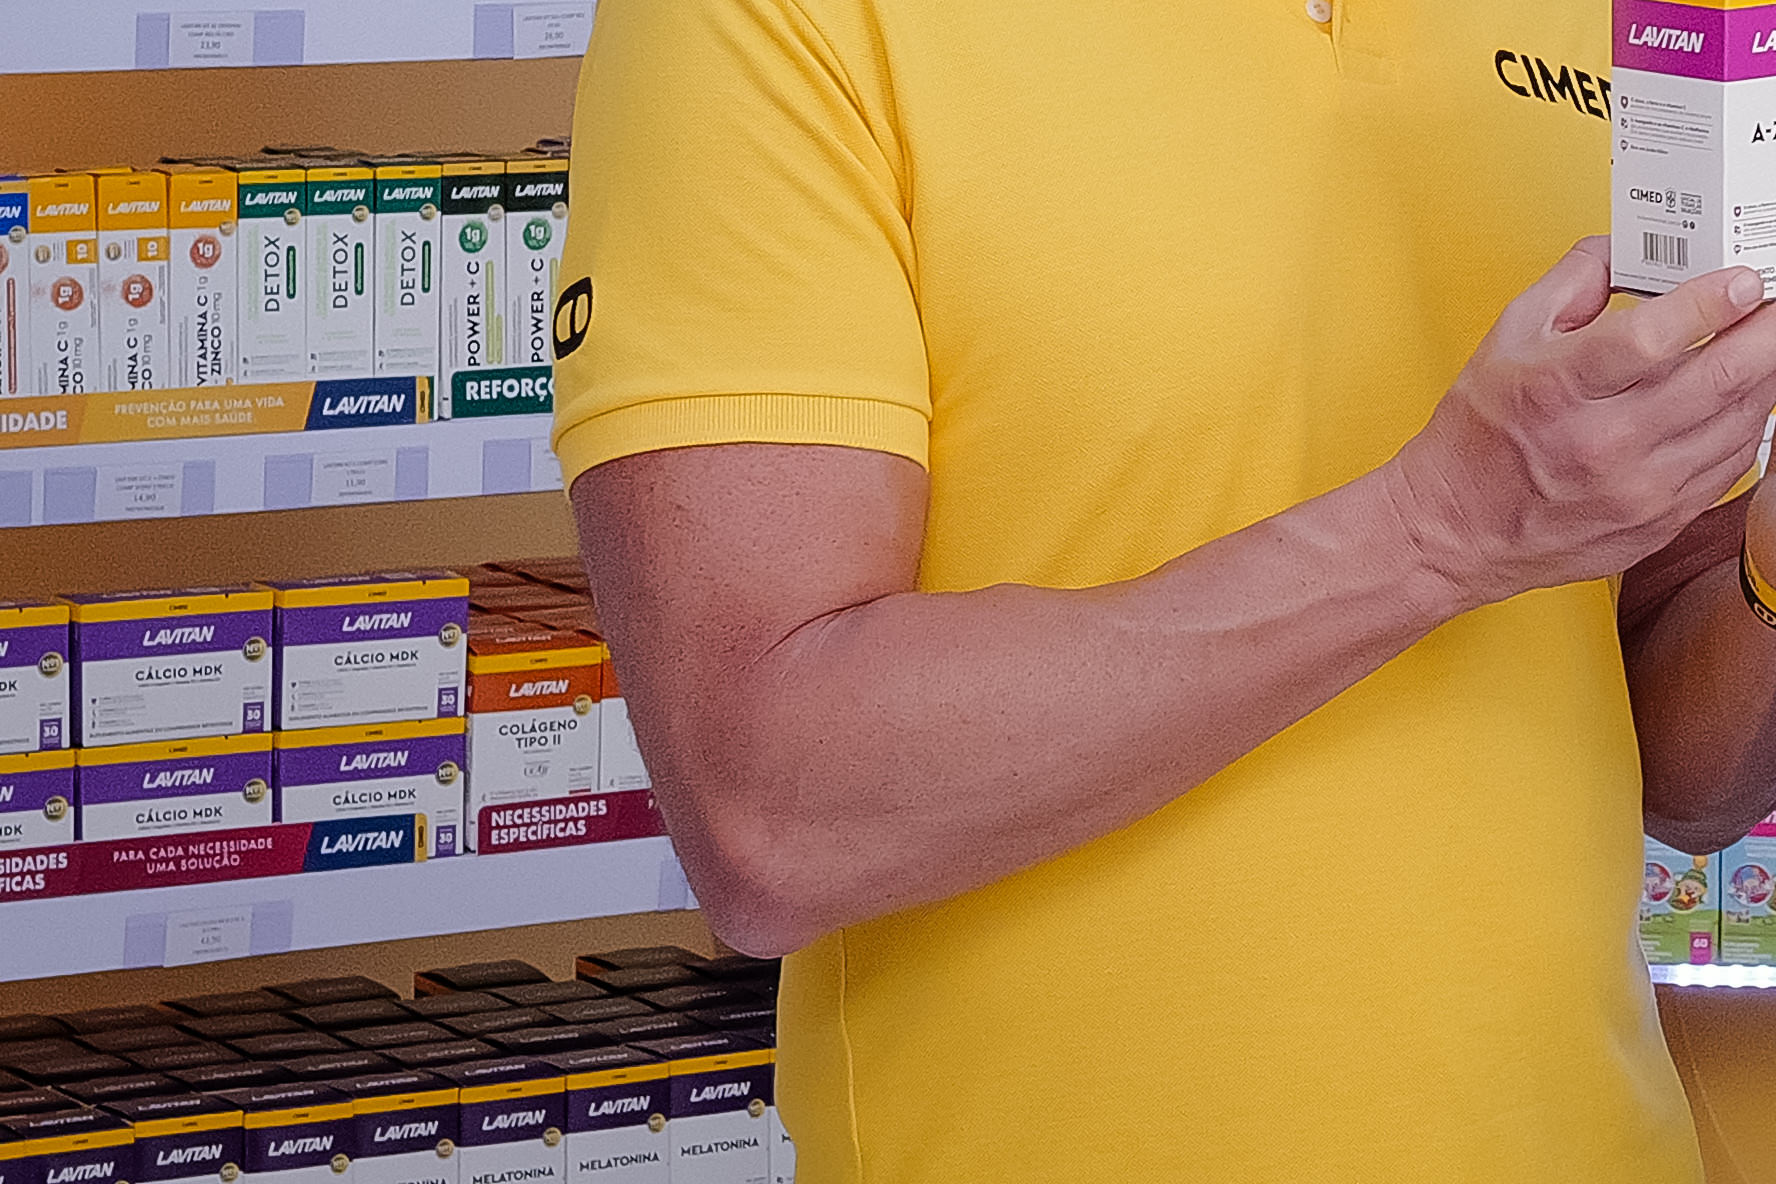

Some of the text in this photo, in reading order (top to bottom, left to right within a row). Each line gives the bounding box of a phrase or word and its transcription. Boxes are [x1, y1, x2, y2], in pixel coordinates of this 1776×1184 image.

[1628, 23, 1704, 53] LAVITAN
[245, 191, 297, 205] LAVITAN
[383, 186, 433, 200] LAVITAN
[451, 185, 500, 199] LAVITAN
[1630, 188, 1663, 204] CIMED
[264, 235, 280, 312] DETOX
[401, 230, 416, 306] DETOX
[467, 261, 480, 275] C
[467, 293, 480, 367] POWER
[197, 295, 208, 386] VITAMINA C
[211, 326, 222, 375] ZINCO
[466, 376, 554, 402] REFORÇ
[190, 399, 220, 412] PARA
[224, 398, 252, 410] UMA
[255, 396, 284, 408] VIDA
[323, 394, 405, 416] LAVITAN
[147, 417, 176, 428] COM
[180, 415, 211, 427] MAIS
[342, 612, 412, 632] LAVITAN
[143, 626, 214, 646] LAVITAN
[334, 650, 419, 666] CÁLCIO MDK
[136, 664, 222, 682] CÁLCIO MDK
[509, 679, 569, 697] LAVITAN
[499, 719, 578, 736] COLÁGENO
[516, 735, 548, 749] TIPO
[340, 751, 408, 771] LAVITAN
[143, 768, 214, 789] LAVITAN
[333, 789, 417, 807] CÁLCIO MDK
[136, 806, 223, 824] CÁLCIO MDK
[491, 799, 607, 827] NECESSIDADES
[491, 817, 586, 846] ESPECÍFICAS
[113, 837, 273, 862] PARA CADA NECESSIDADE
[321, 830, 403, 855] LAVITAN
[146, 862, 176, 874] UMA
[690, 1082, 750, 1102] LAVITAN
[588, 1096, 650, 1117] LAVITAN
[482, 1109, 546, 1131] LAVITAN
[374, 1121, 438, 1142] LAVITAN
[156, 1144, 222, 1166] LAVITAN
[268, 1136, 333, 1157] LAVITAN
[681, 1137, 759, 1157] MELATONINA
[579, 1151, 660, 1172] MELATONINA
[47, 1162, 114, 1184] LAVITAN
[473, 1166, 555, 1184] MELATONINA
